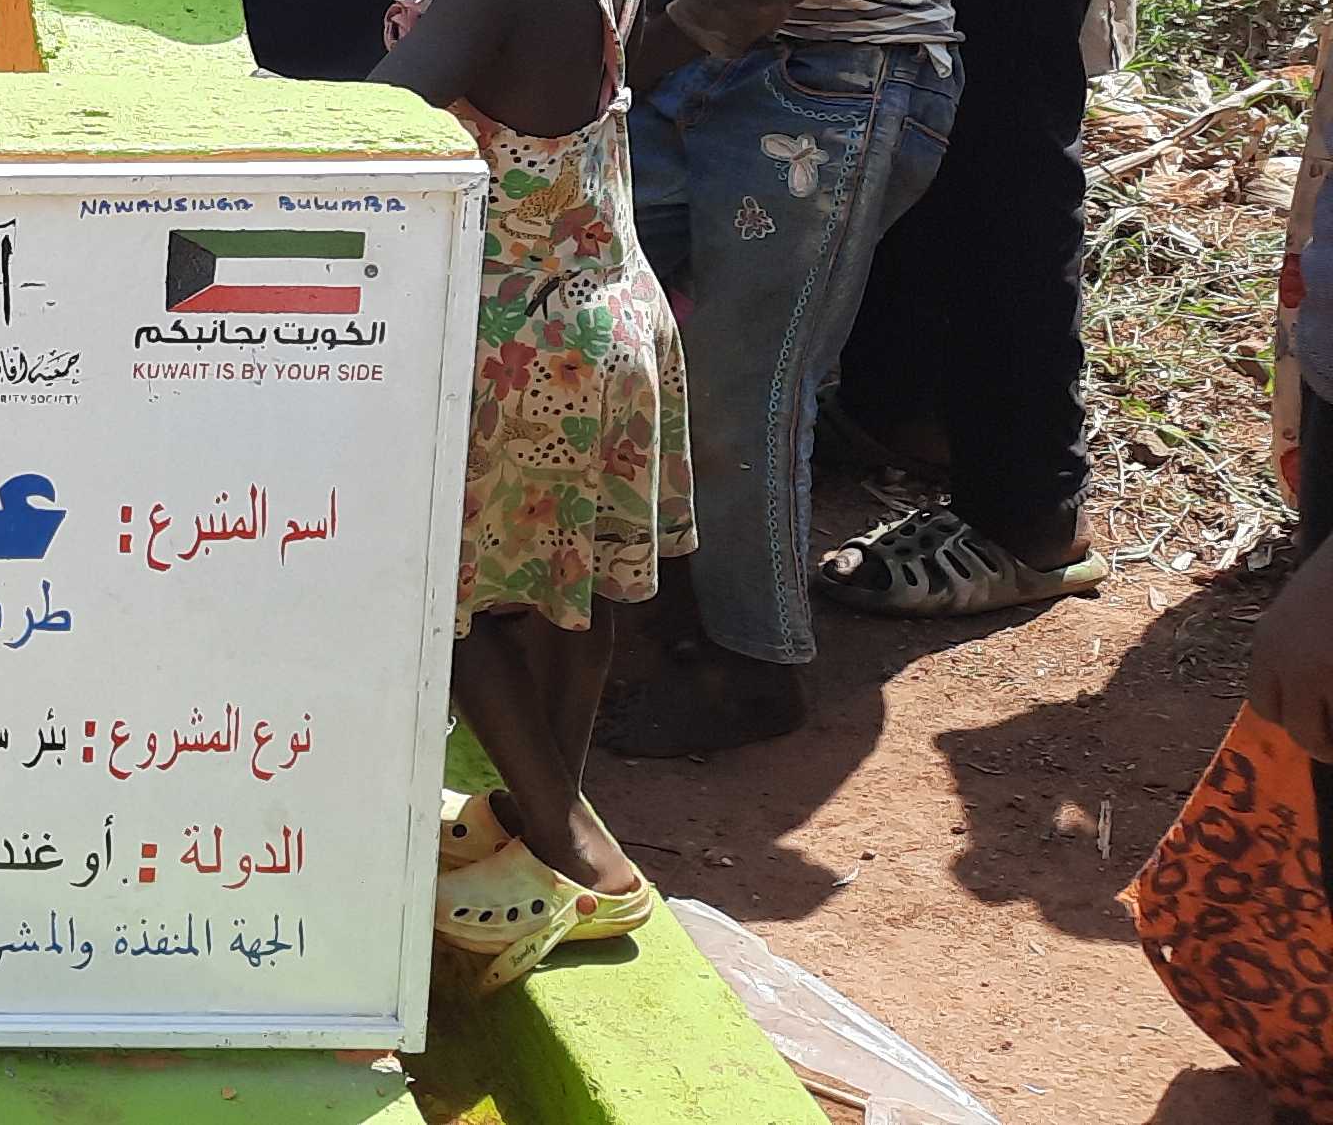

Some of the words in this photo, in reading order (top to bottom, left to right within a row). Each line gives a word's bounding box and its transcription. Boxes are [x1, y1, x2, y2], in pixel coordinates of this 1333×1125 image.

[278, 195, 406, 213] BULUMBA
[134, 318, 267, 352] بجانبكم
[273, 320, 386, 351] الكويت
[132, 362, 211, 380] KUWAIT
[216, 362, 235, 381] IS
[241, 362, 268, 384] BY
[274, 363, 331, 381] YOUR
[337, 363, 383, 382] SIDE
[280, 486, 337, 566] اسم
[21, 707, 67, 769] بئر
[251, 713, 311, 782] نوع
[179, 824, 303, 890] الدولة
[114, 912, 212, 957] المنفذة
[229, 914, 305, 968] الجهة
